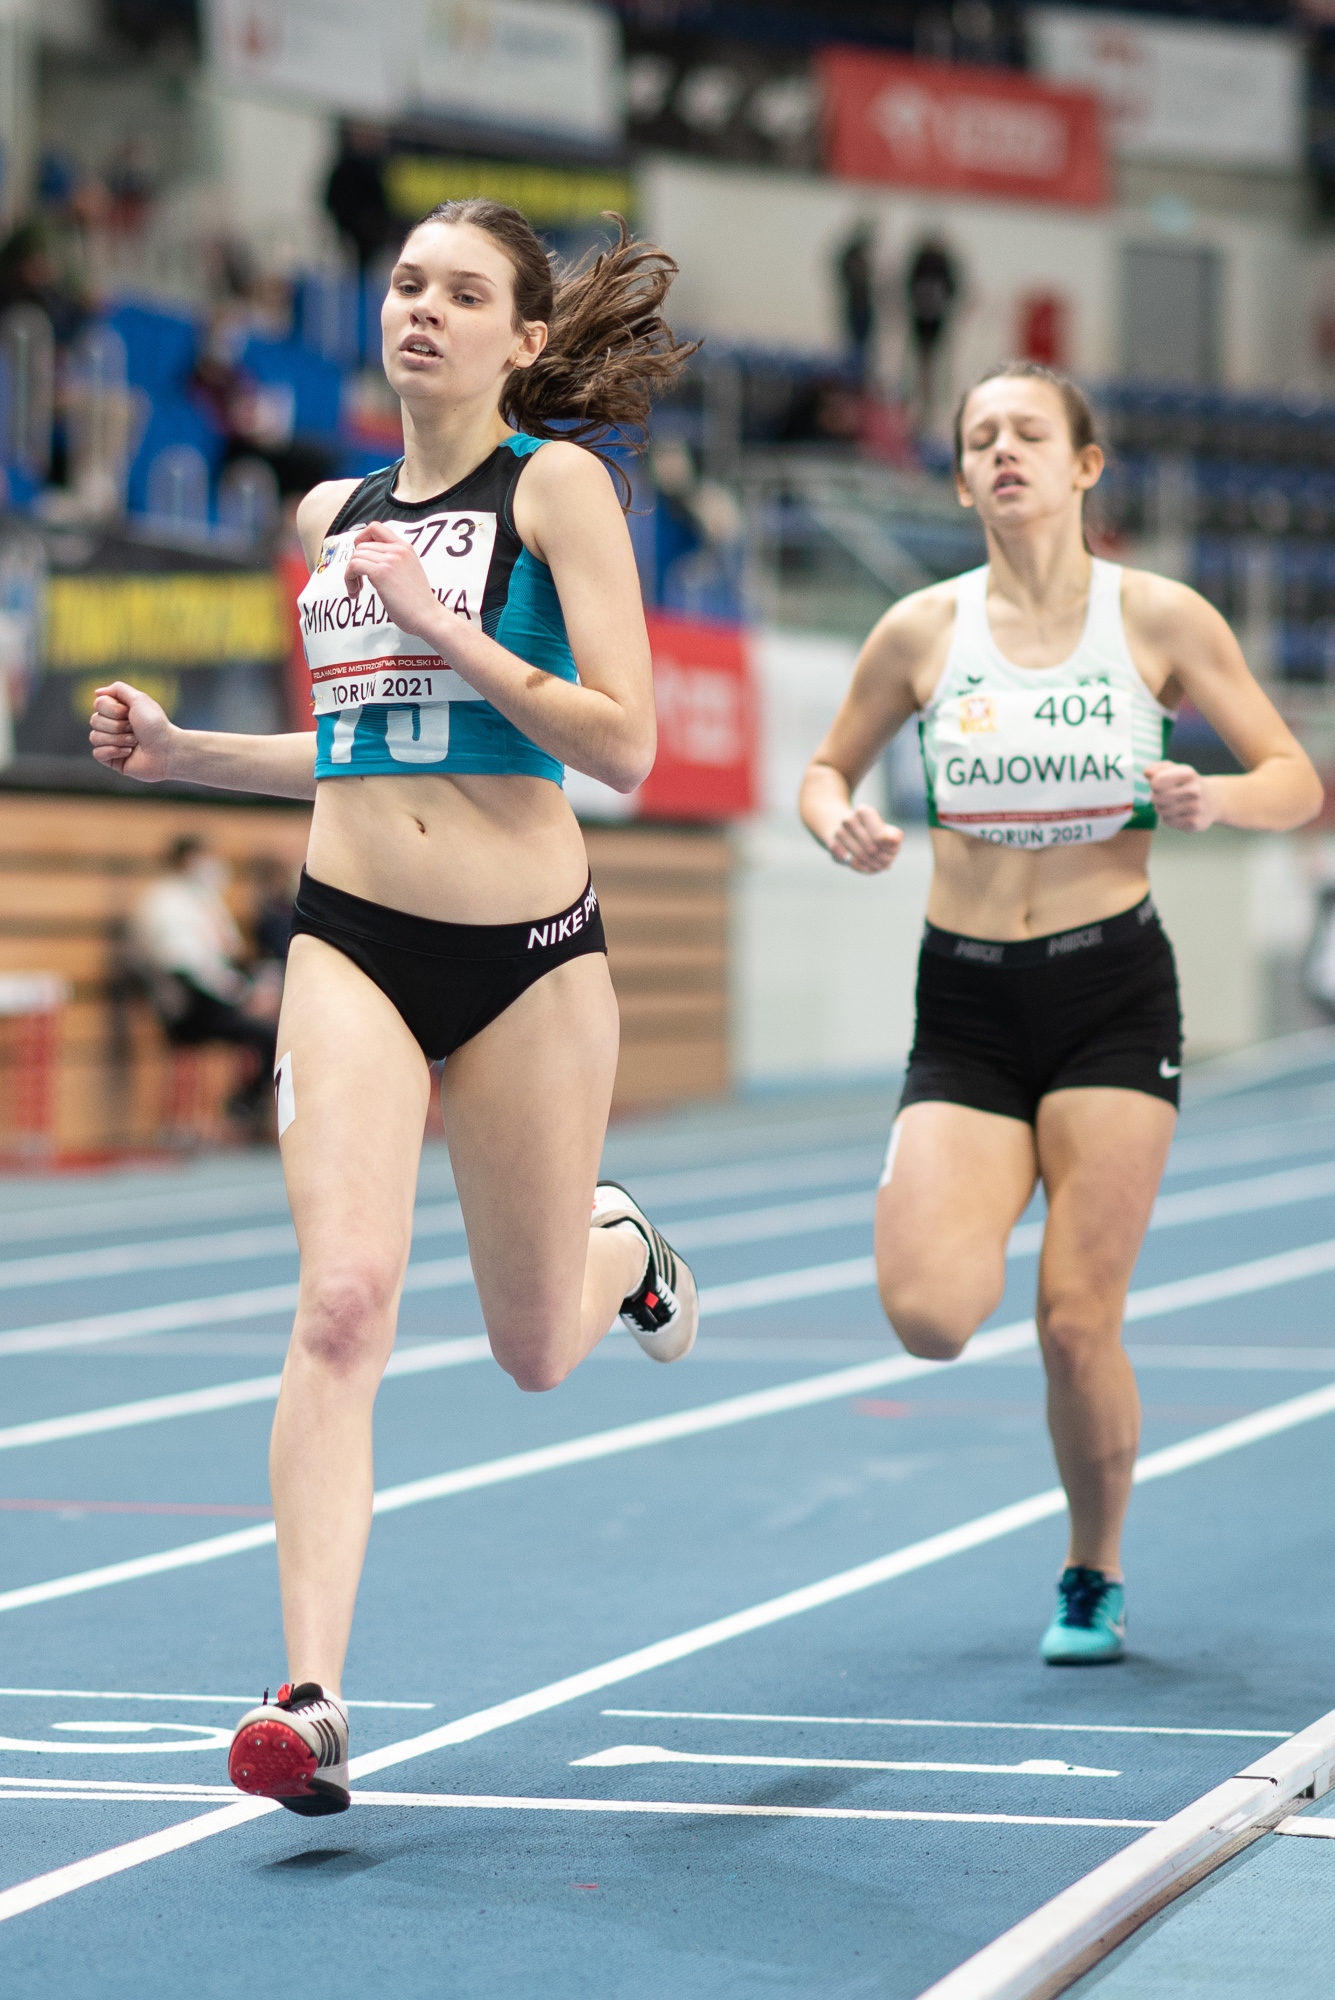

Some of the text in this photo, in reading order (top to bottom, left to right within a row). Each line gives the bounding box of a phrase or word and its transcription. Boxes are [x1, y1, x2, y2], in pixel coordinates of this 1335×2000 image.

[325, 666, 347, 676] HALOWE
[348, 660, 396, 673] MISTRZOSTWA
[332, 674, 433, 705] TORUŃ 2021
[1034, 694, 1115, 726] 404
[946, 754, 1125, 785] GAJOWIAK
[1051, 824, 1092, 843] 2021
[527, 906, 583, 950] NIKE
[1047, 924, 1103, 958] NIKE
